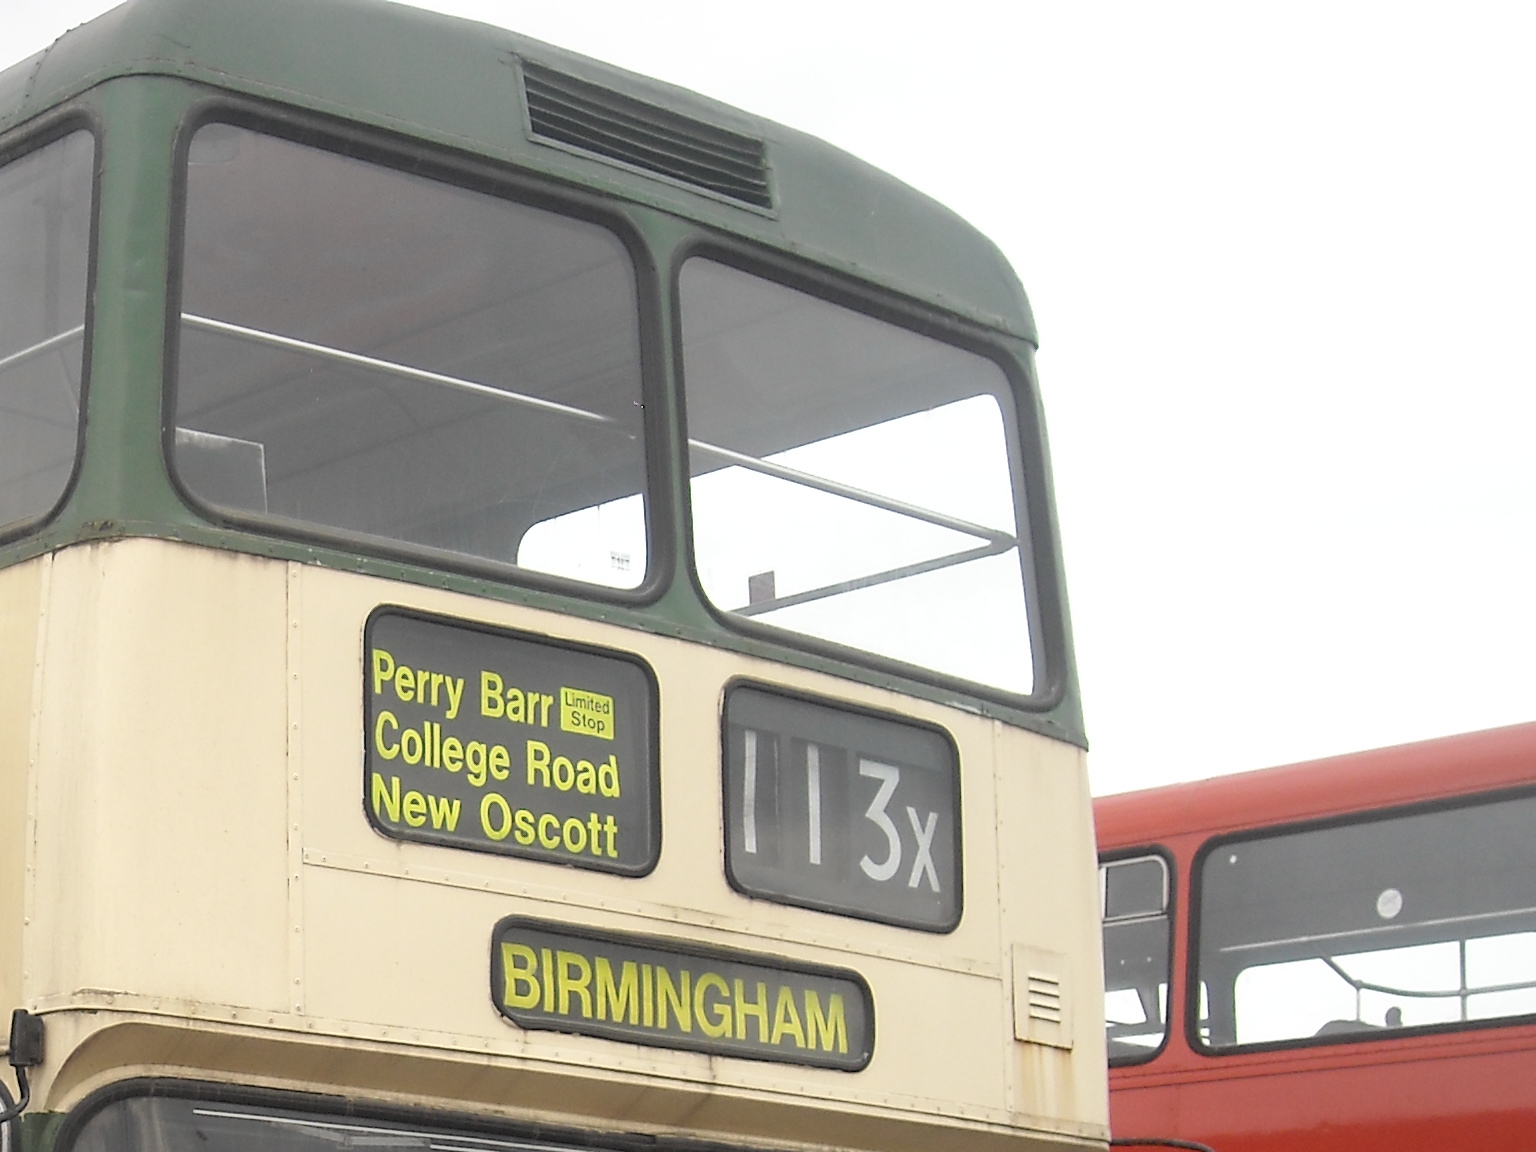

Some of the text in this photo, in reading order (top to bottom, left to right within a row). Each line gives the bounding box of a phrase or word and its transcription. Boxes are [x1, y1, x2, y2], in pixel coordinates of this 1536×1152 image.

[372, 648, 554, 728] Perry Barr
[564, 691, 611, 715] Limited
[570, 710, 606, 734] Stop
[374, 710, 621, 798] College Road
[371, 772, 619, 858] New Oscott
[501, 941, 848, 1055] BIRMINGHAM
